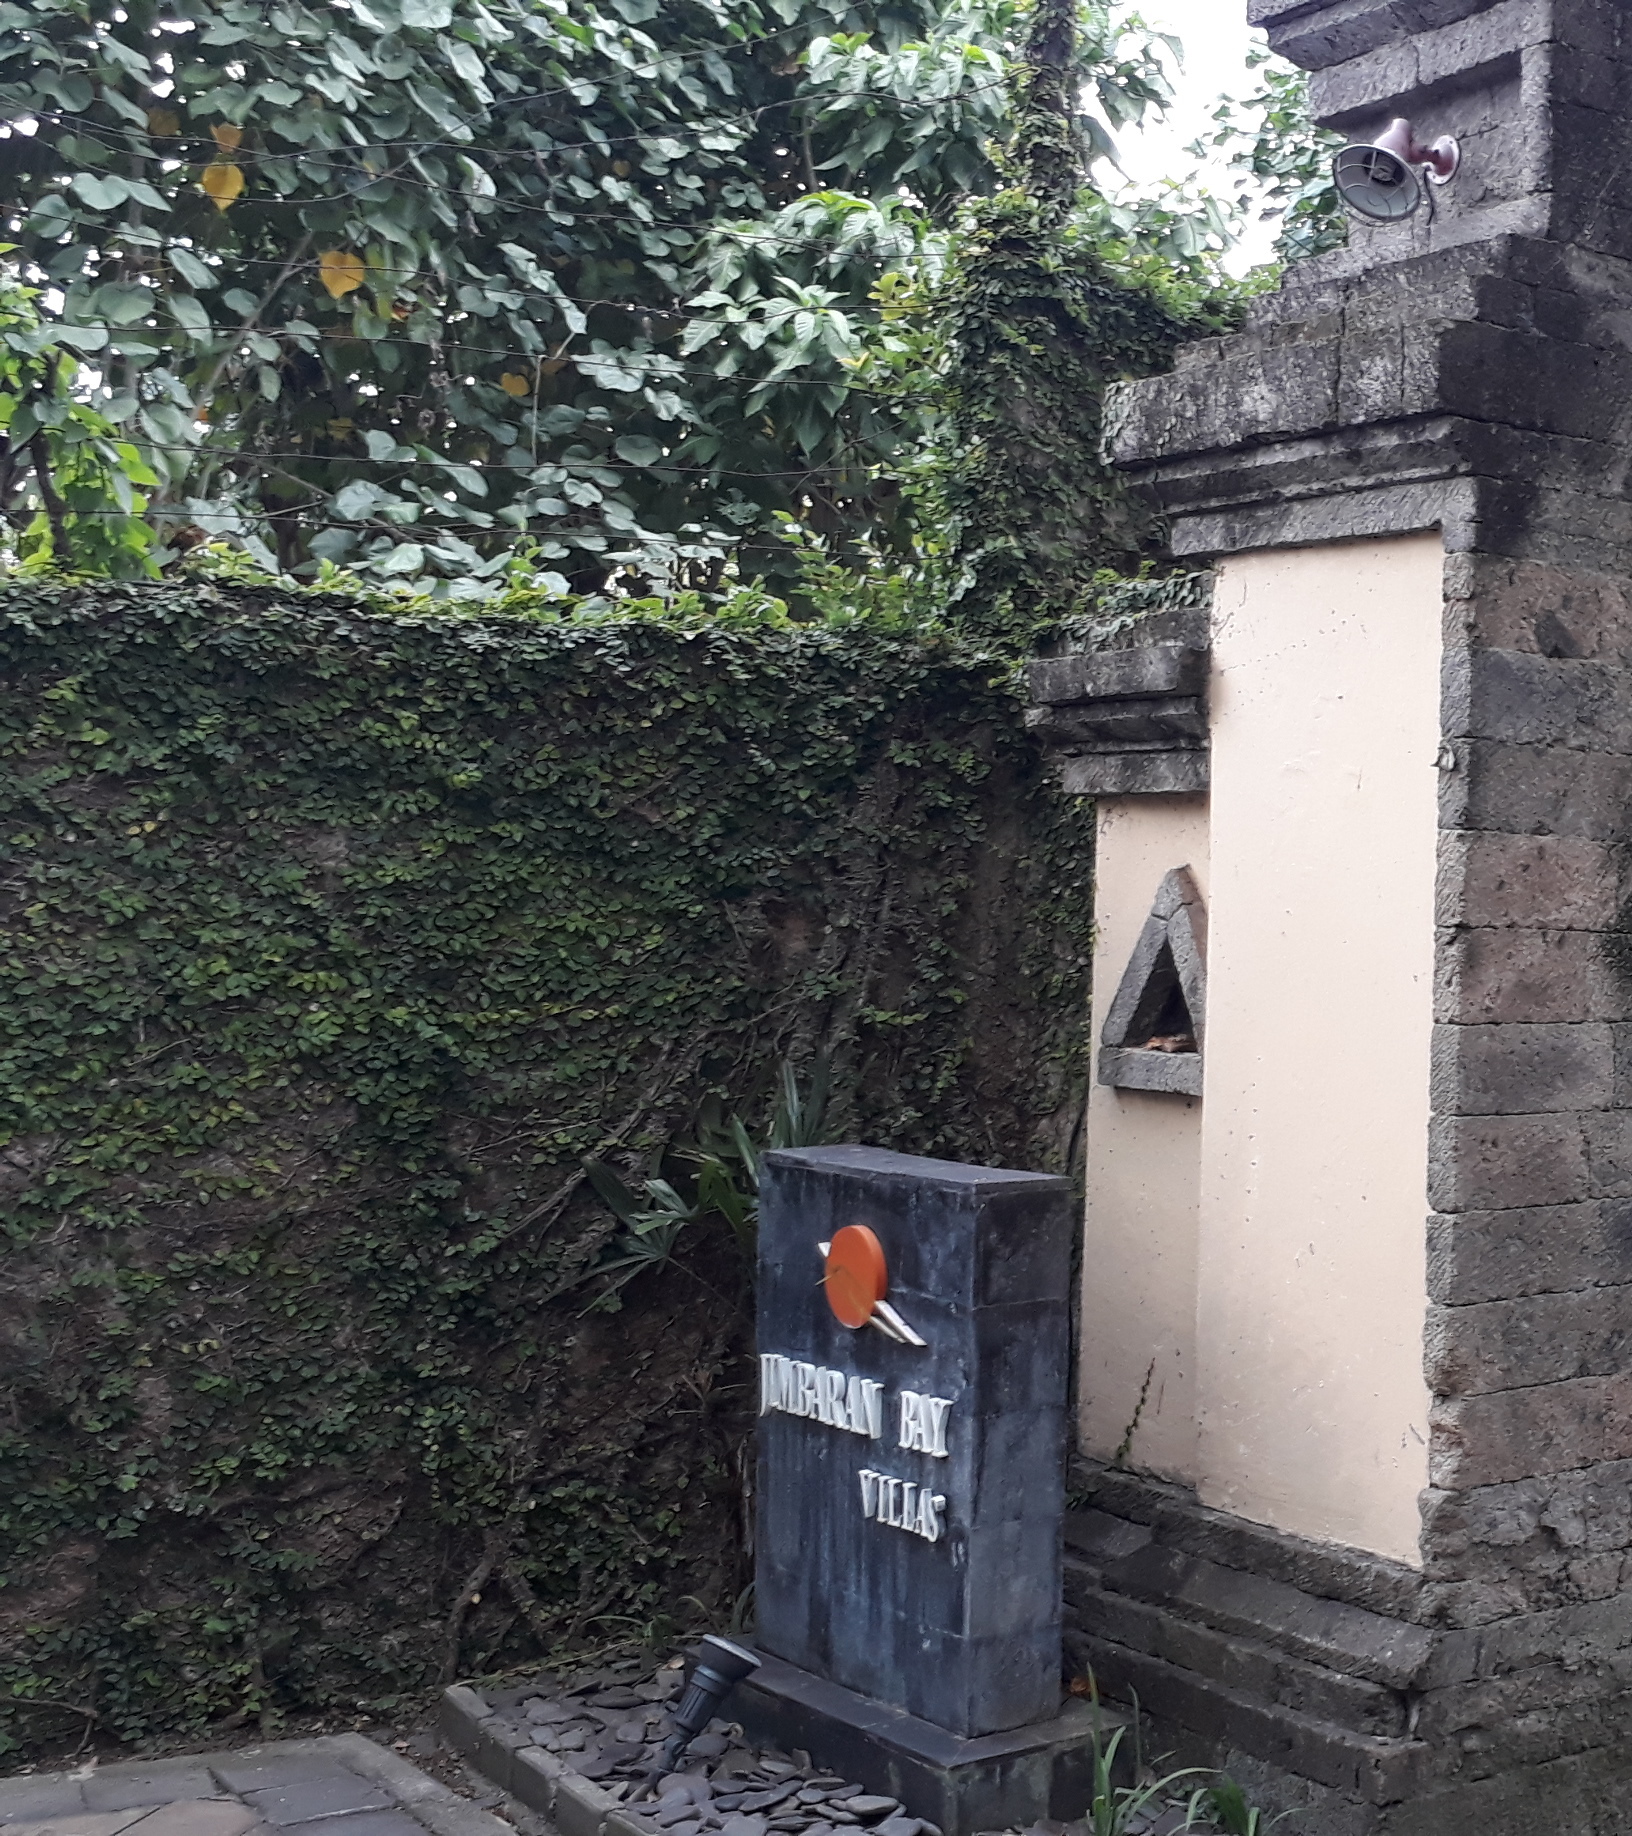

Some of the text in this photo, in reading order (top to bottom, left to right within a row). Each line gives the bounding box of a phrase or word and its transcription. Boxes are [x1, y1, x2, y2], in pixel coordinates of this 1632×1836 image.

[760, 1354, 954, 1458] JIMBARAN BAY
[858, 1469, 946, 1542] VILLAS
